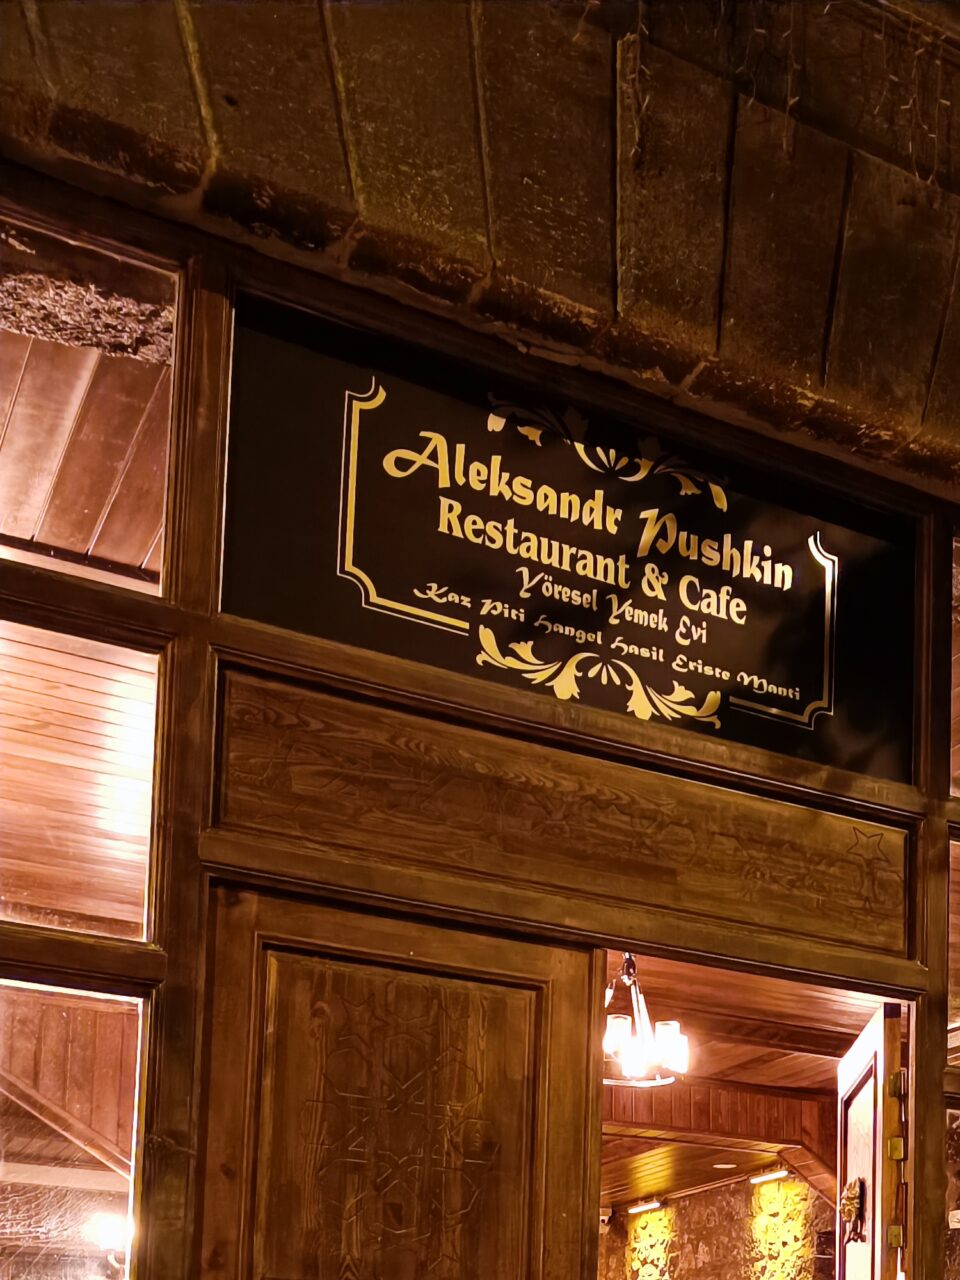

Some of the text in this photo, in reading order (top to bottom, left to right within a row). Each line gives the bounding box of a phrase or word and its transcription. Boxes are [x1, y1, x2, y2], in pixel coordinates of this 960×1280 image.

[382, 430, 793, 592] Aleksandr Pushkin
[437, 495, 748, 626] Restaurant & Cafe
[413, 582, 472, 609] Kaz
[515, 566, 708, 646] Yöresel Yemek Evi
